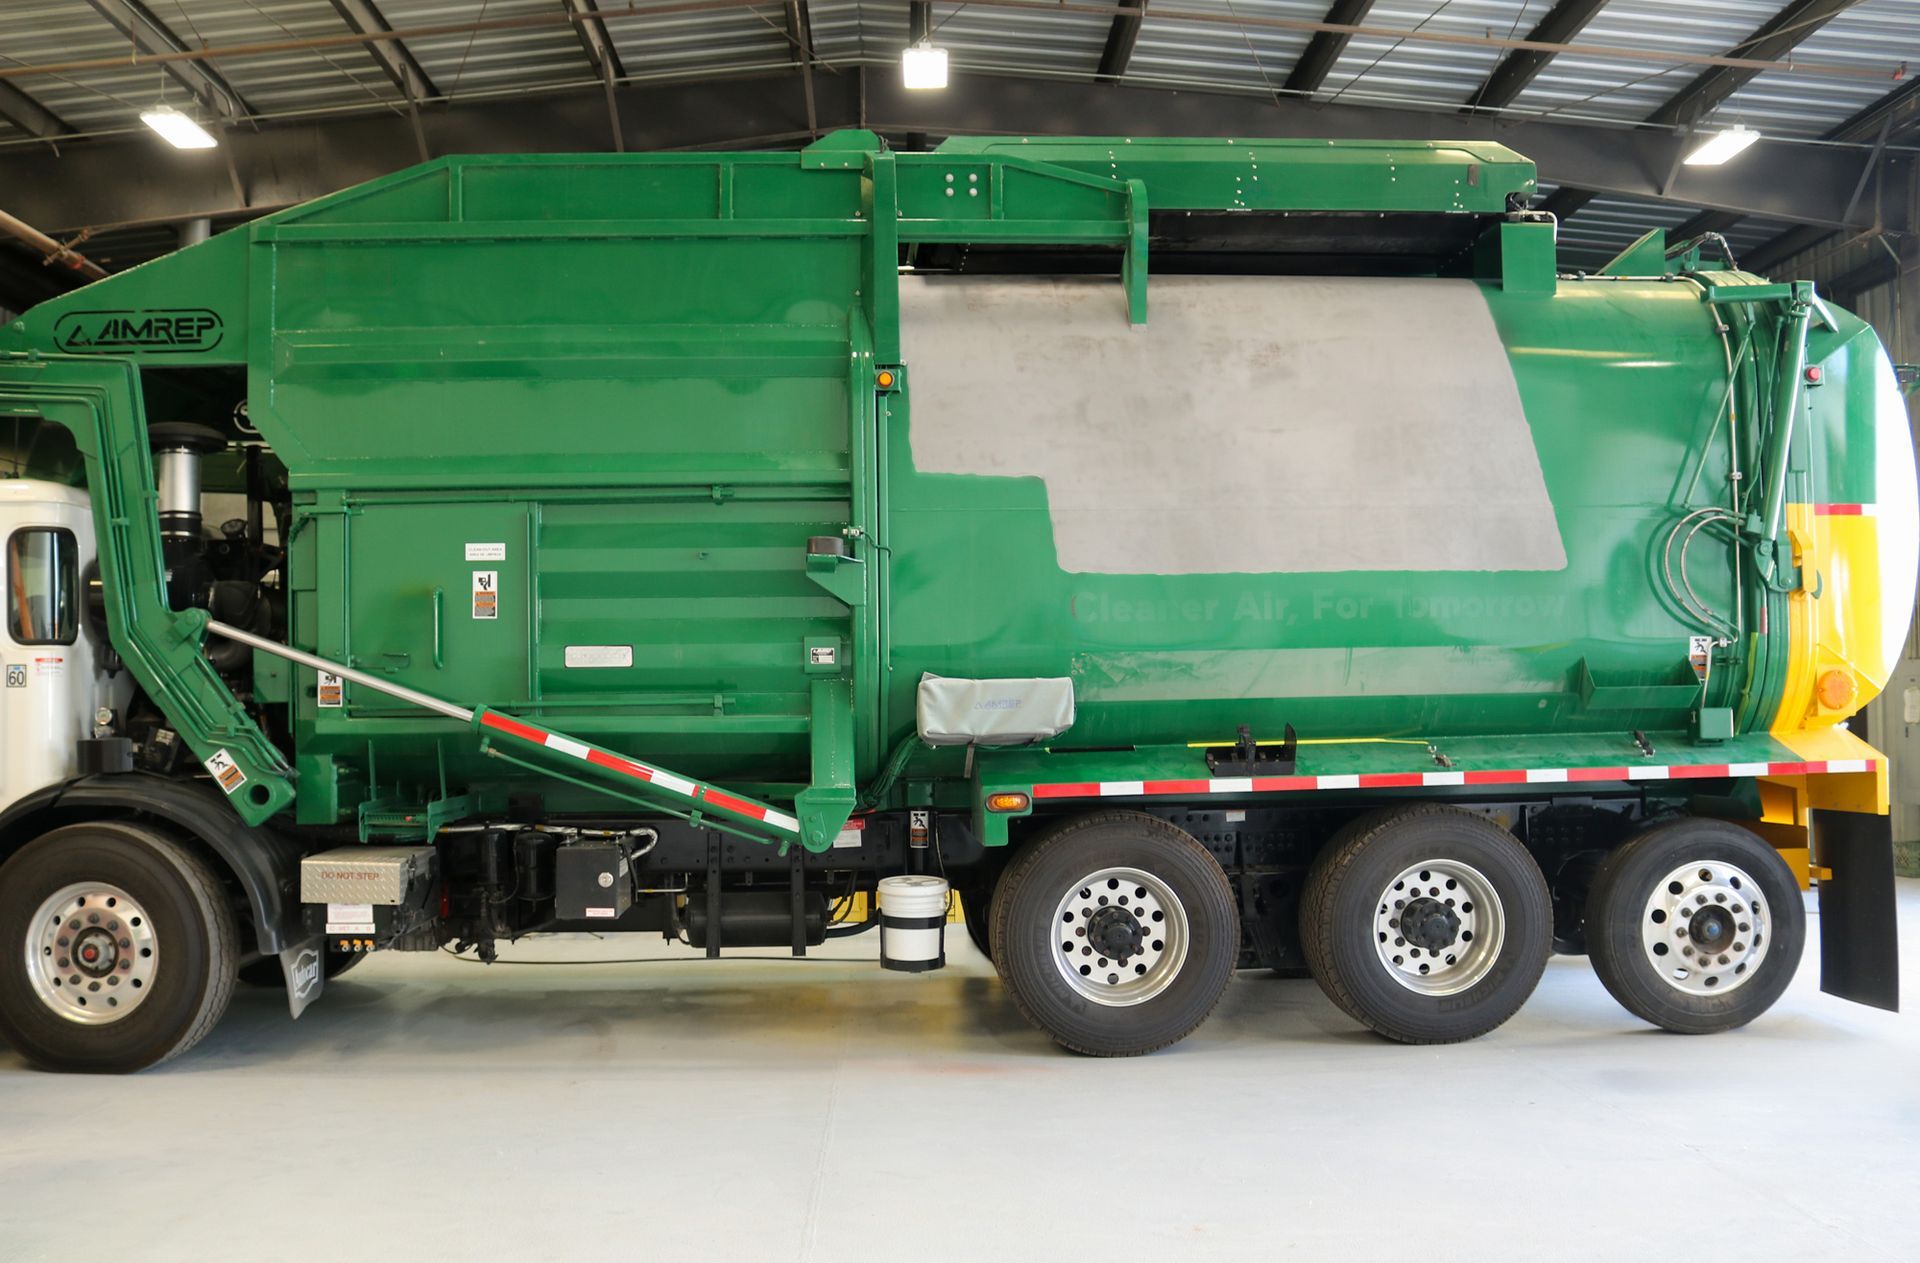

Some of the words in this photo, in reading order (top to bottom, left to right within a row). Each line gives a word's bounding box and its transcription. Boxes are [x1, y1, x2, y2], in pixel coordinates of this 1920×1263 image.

[98, 317, 215, 342] AMREP
[1070, 591, 1219, 622] Cleaner
[1232, 590, 1297, 626] Air,
[1312, 588, 1374, 619] For
[1386, 587, 1568, 619] Tomorrow
[9, 671, 24, 685] 60
[321, 871, 335, 880] DO
[336, 871, 355, 880] NOT
[356, 872, 380, 880] STEP
